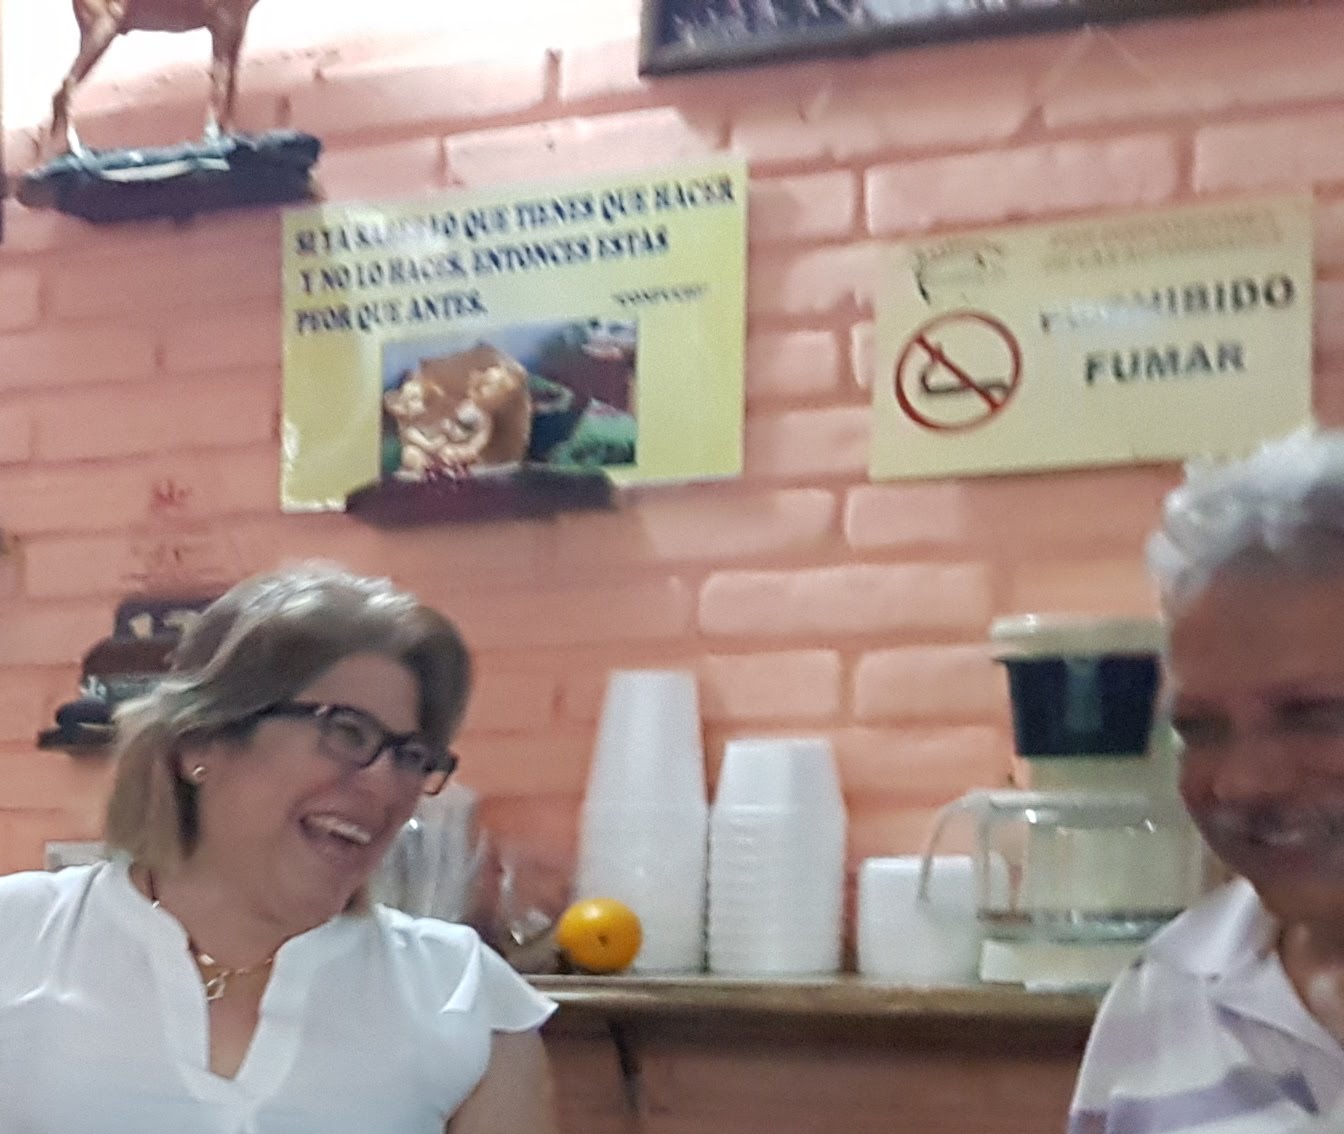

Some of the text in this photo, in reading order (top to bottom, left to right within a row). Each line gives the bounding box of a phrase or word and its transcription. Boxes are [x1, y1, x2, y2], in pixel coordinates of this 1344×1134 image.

[464, 206, 508, 241] QUE
[515, 193, 594, 229] TIENES
[601, 186, 649, 223] QUE
[654, 174, 735, 212] HACER
[320, 264, 351, 291] NO
[356, 259, 385, 288] LO
[472, 237, 591, 276] ENTONCES
[295, 303, 353, 336] PEOR
[357, 299, 401, 332] QUE
[1039, 272, 1296, 336] PHIBIDO
[1084, 341, 1247, 387] FUMAR
